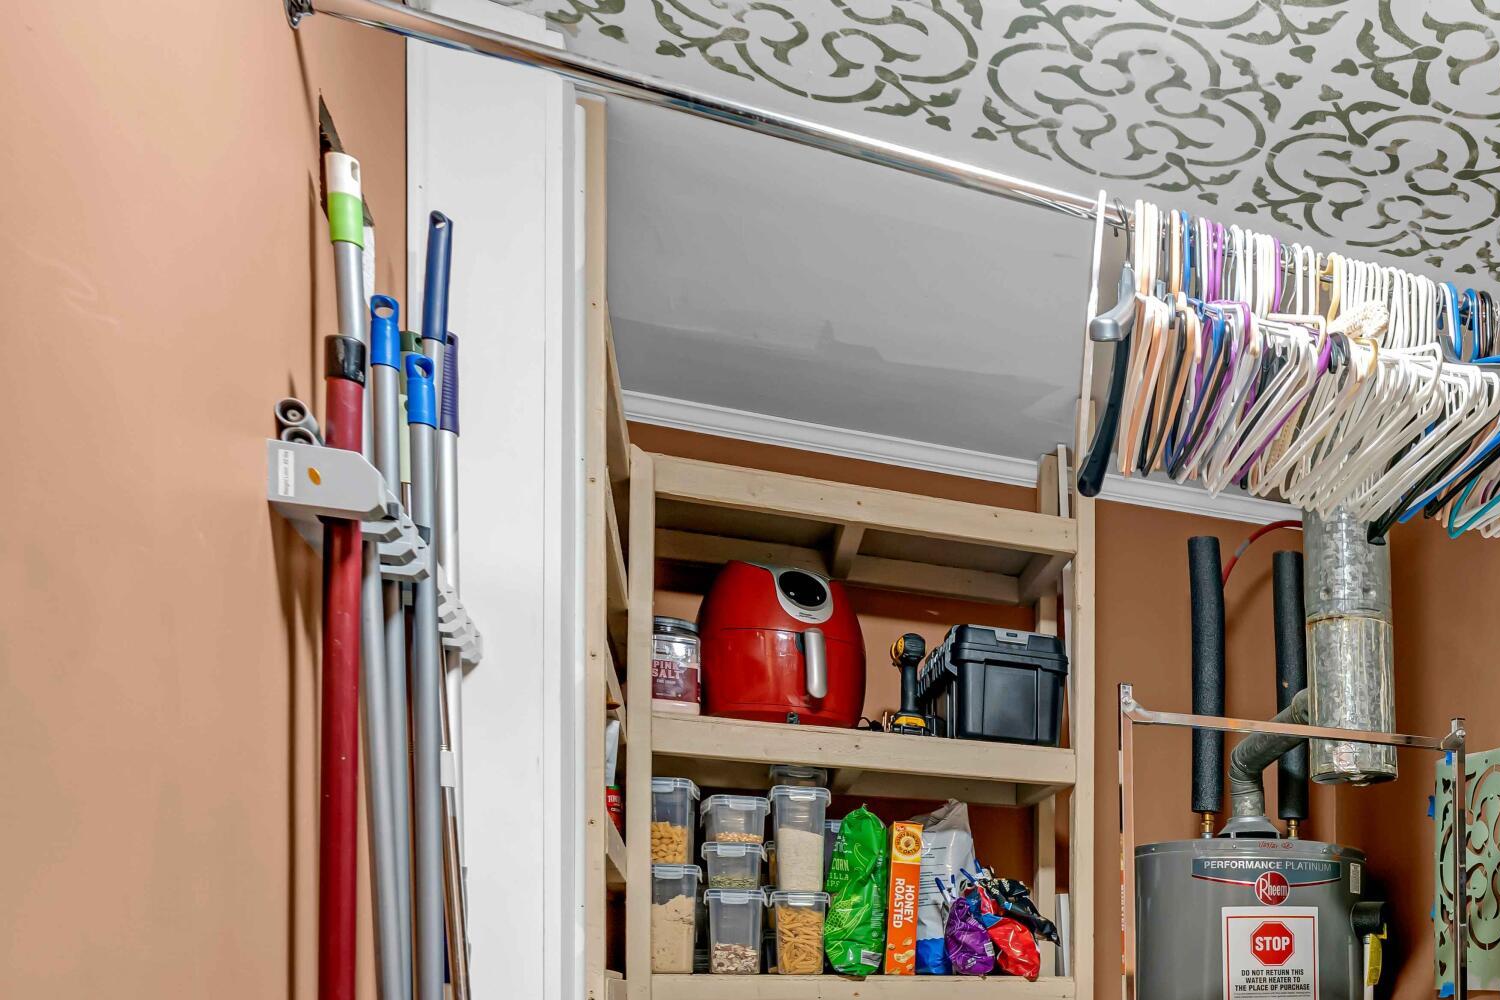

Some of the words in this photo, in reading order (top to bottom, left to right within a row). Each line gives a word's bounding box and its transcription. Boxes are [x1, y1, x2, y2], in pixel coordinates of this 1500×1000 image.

[653, 660, 680, 671] PINK
[652, 668, 680, 679] SALT
[832, 858, 849, 871] CORN
[1204, 860, 1283, 870] PERFORMANCE
[1285, 861, 1332, 872] PLATINUM
[829, 873, 849, 881] ILLA
[1259, 872, 1288, 901] Rheem
[893, 878, 906, 928] ROASTED
[903, 885, 915, 923] HONEY
[1255, 936, 1291, 951] STOP
